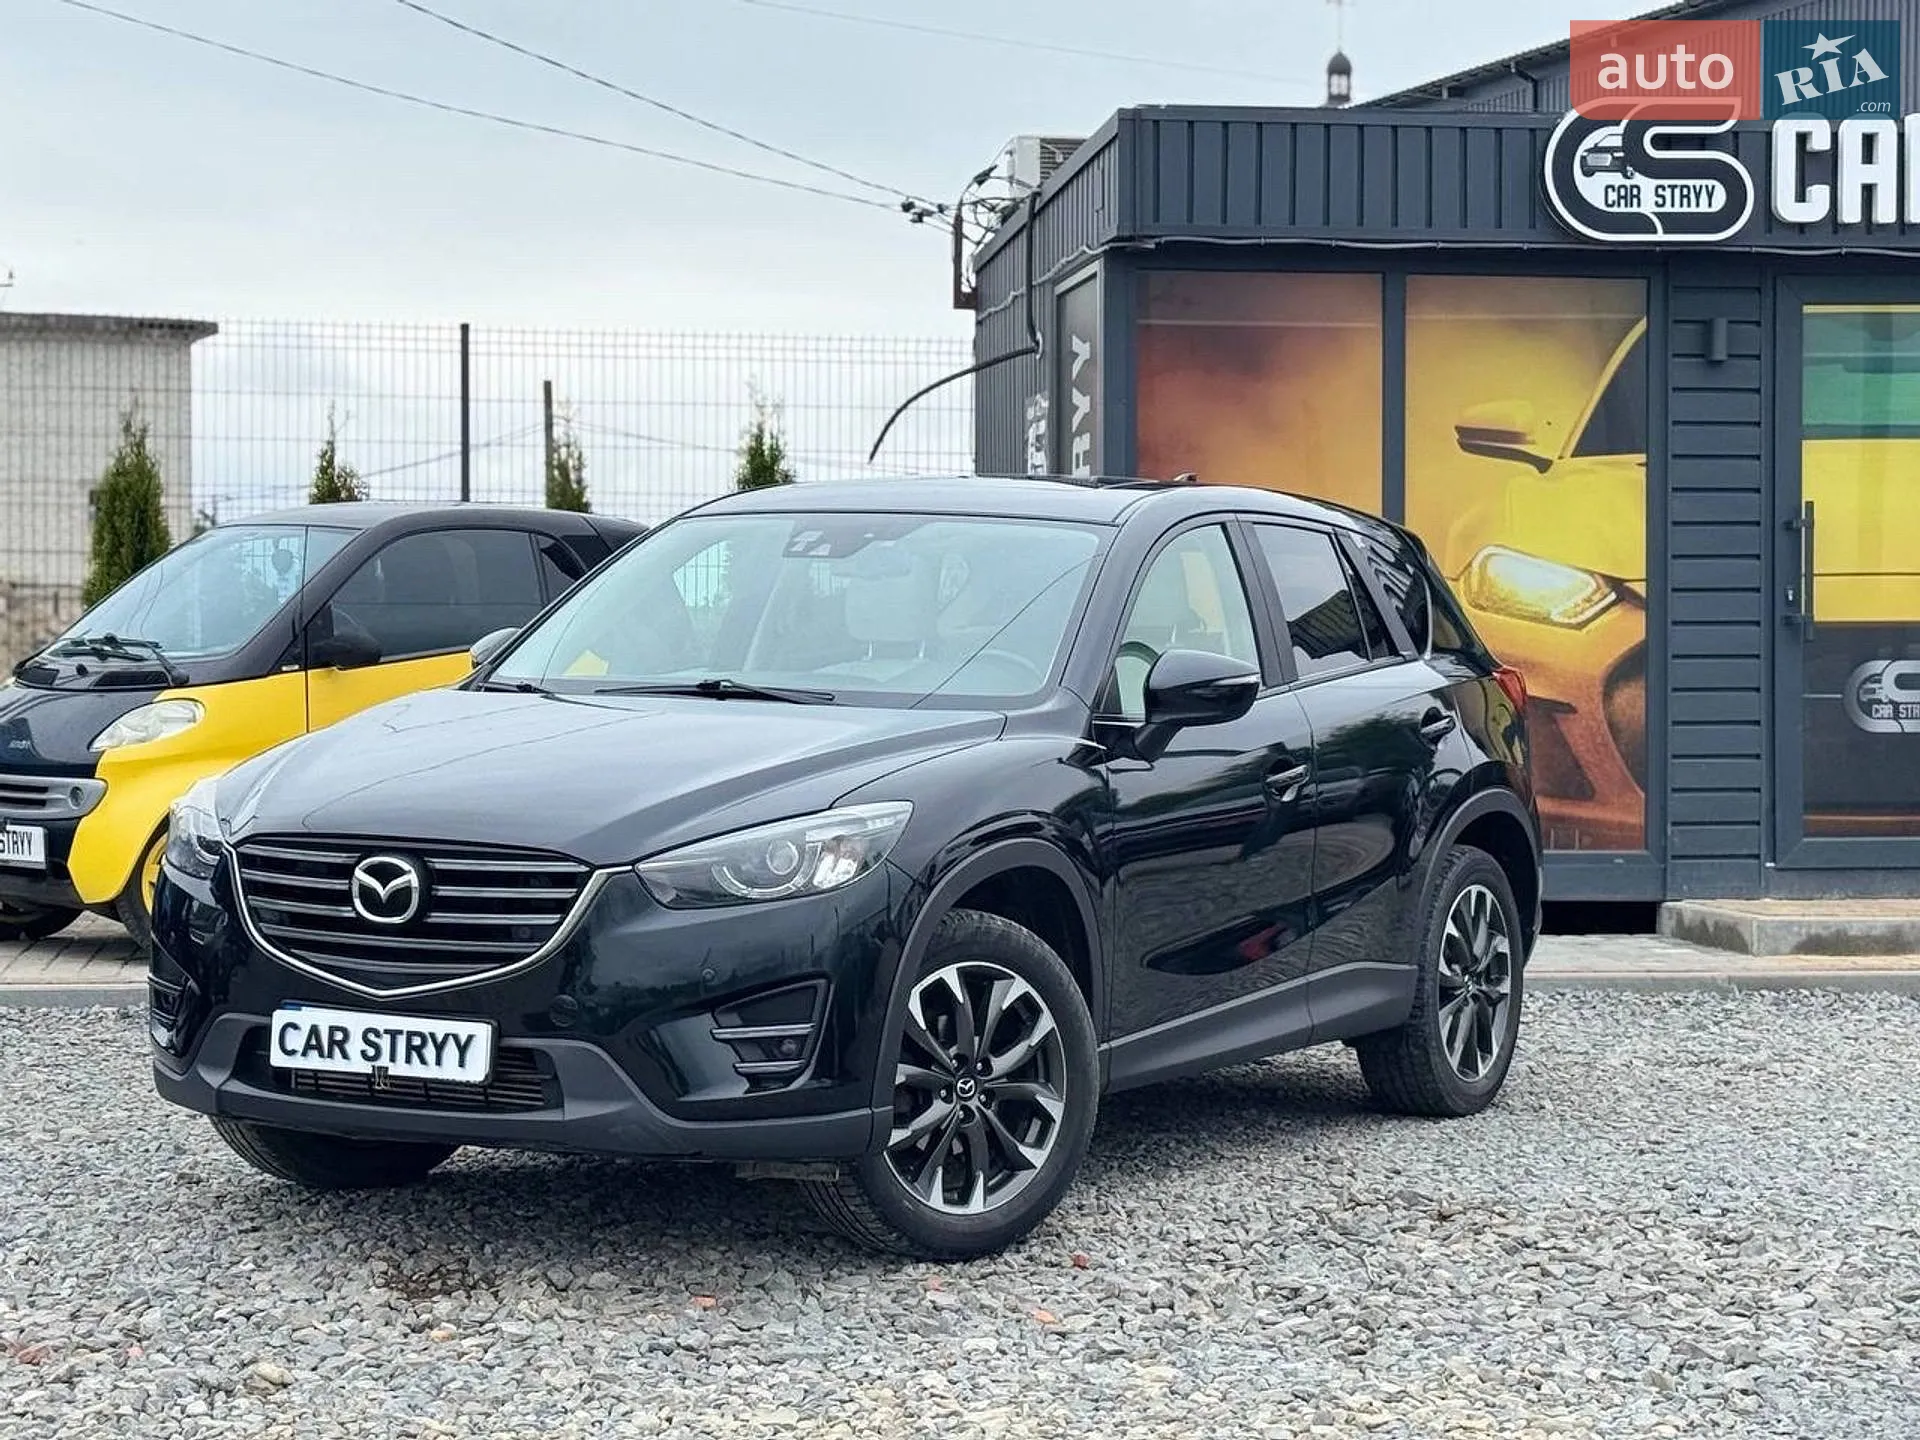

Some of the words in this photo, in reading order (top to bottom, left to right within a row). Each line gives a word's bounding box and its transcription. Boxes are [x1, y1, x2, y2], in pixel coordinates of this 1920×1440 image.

[1604, 184, 1642, 209] CAR
[1654, 184, 1716, 209] STRYY
[1871, 704, 1894, 718] CAR
[277, 1021, 351, 1061] CAR
[359, 1026, 477, 1068] STRYY
